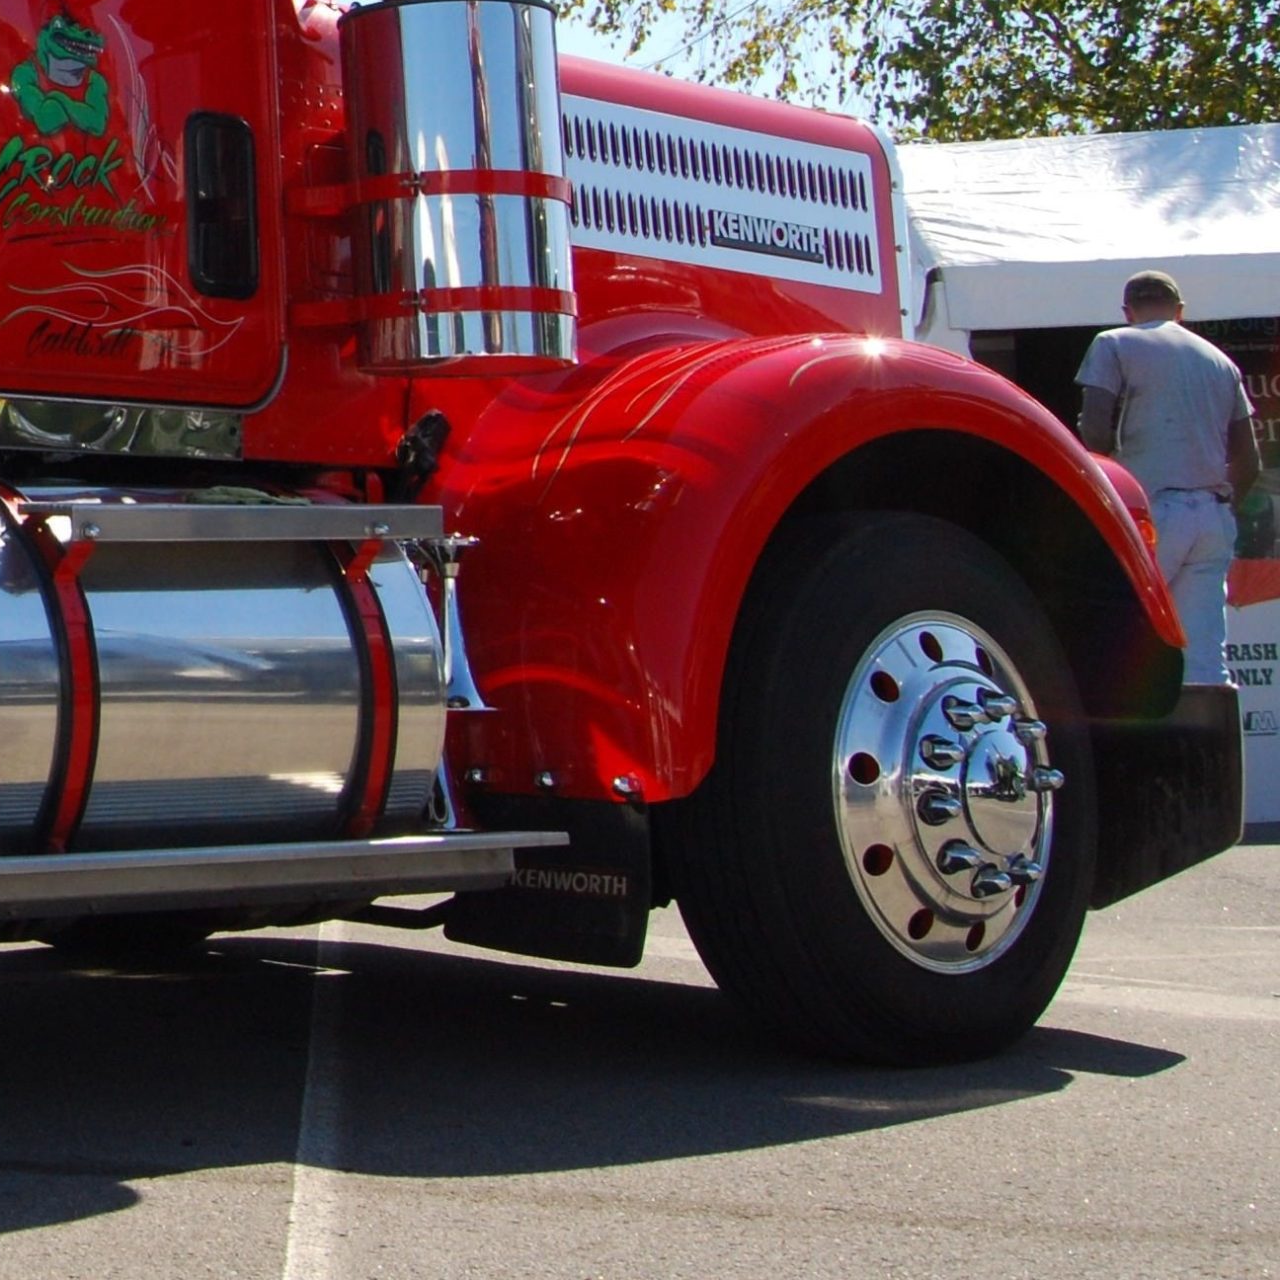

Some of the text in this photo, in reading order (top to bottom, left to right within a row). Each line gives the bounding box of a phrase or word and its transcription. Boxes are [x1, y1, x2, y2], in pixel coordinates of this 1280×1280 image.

[711, 210, 821, 254] KENWORTH
[1225, 643, 1278, 661] RASH
[511, 870, 627, 895] KENWORTH
